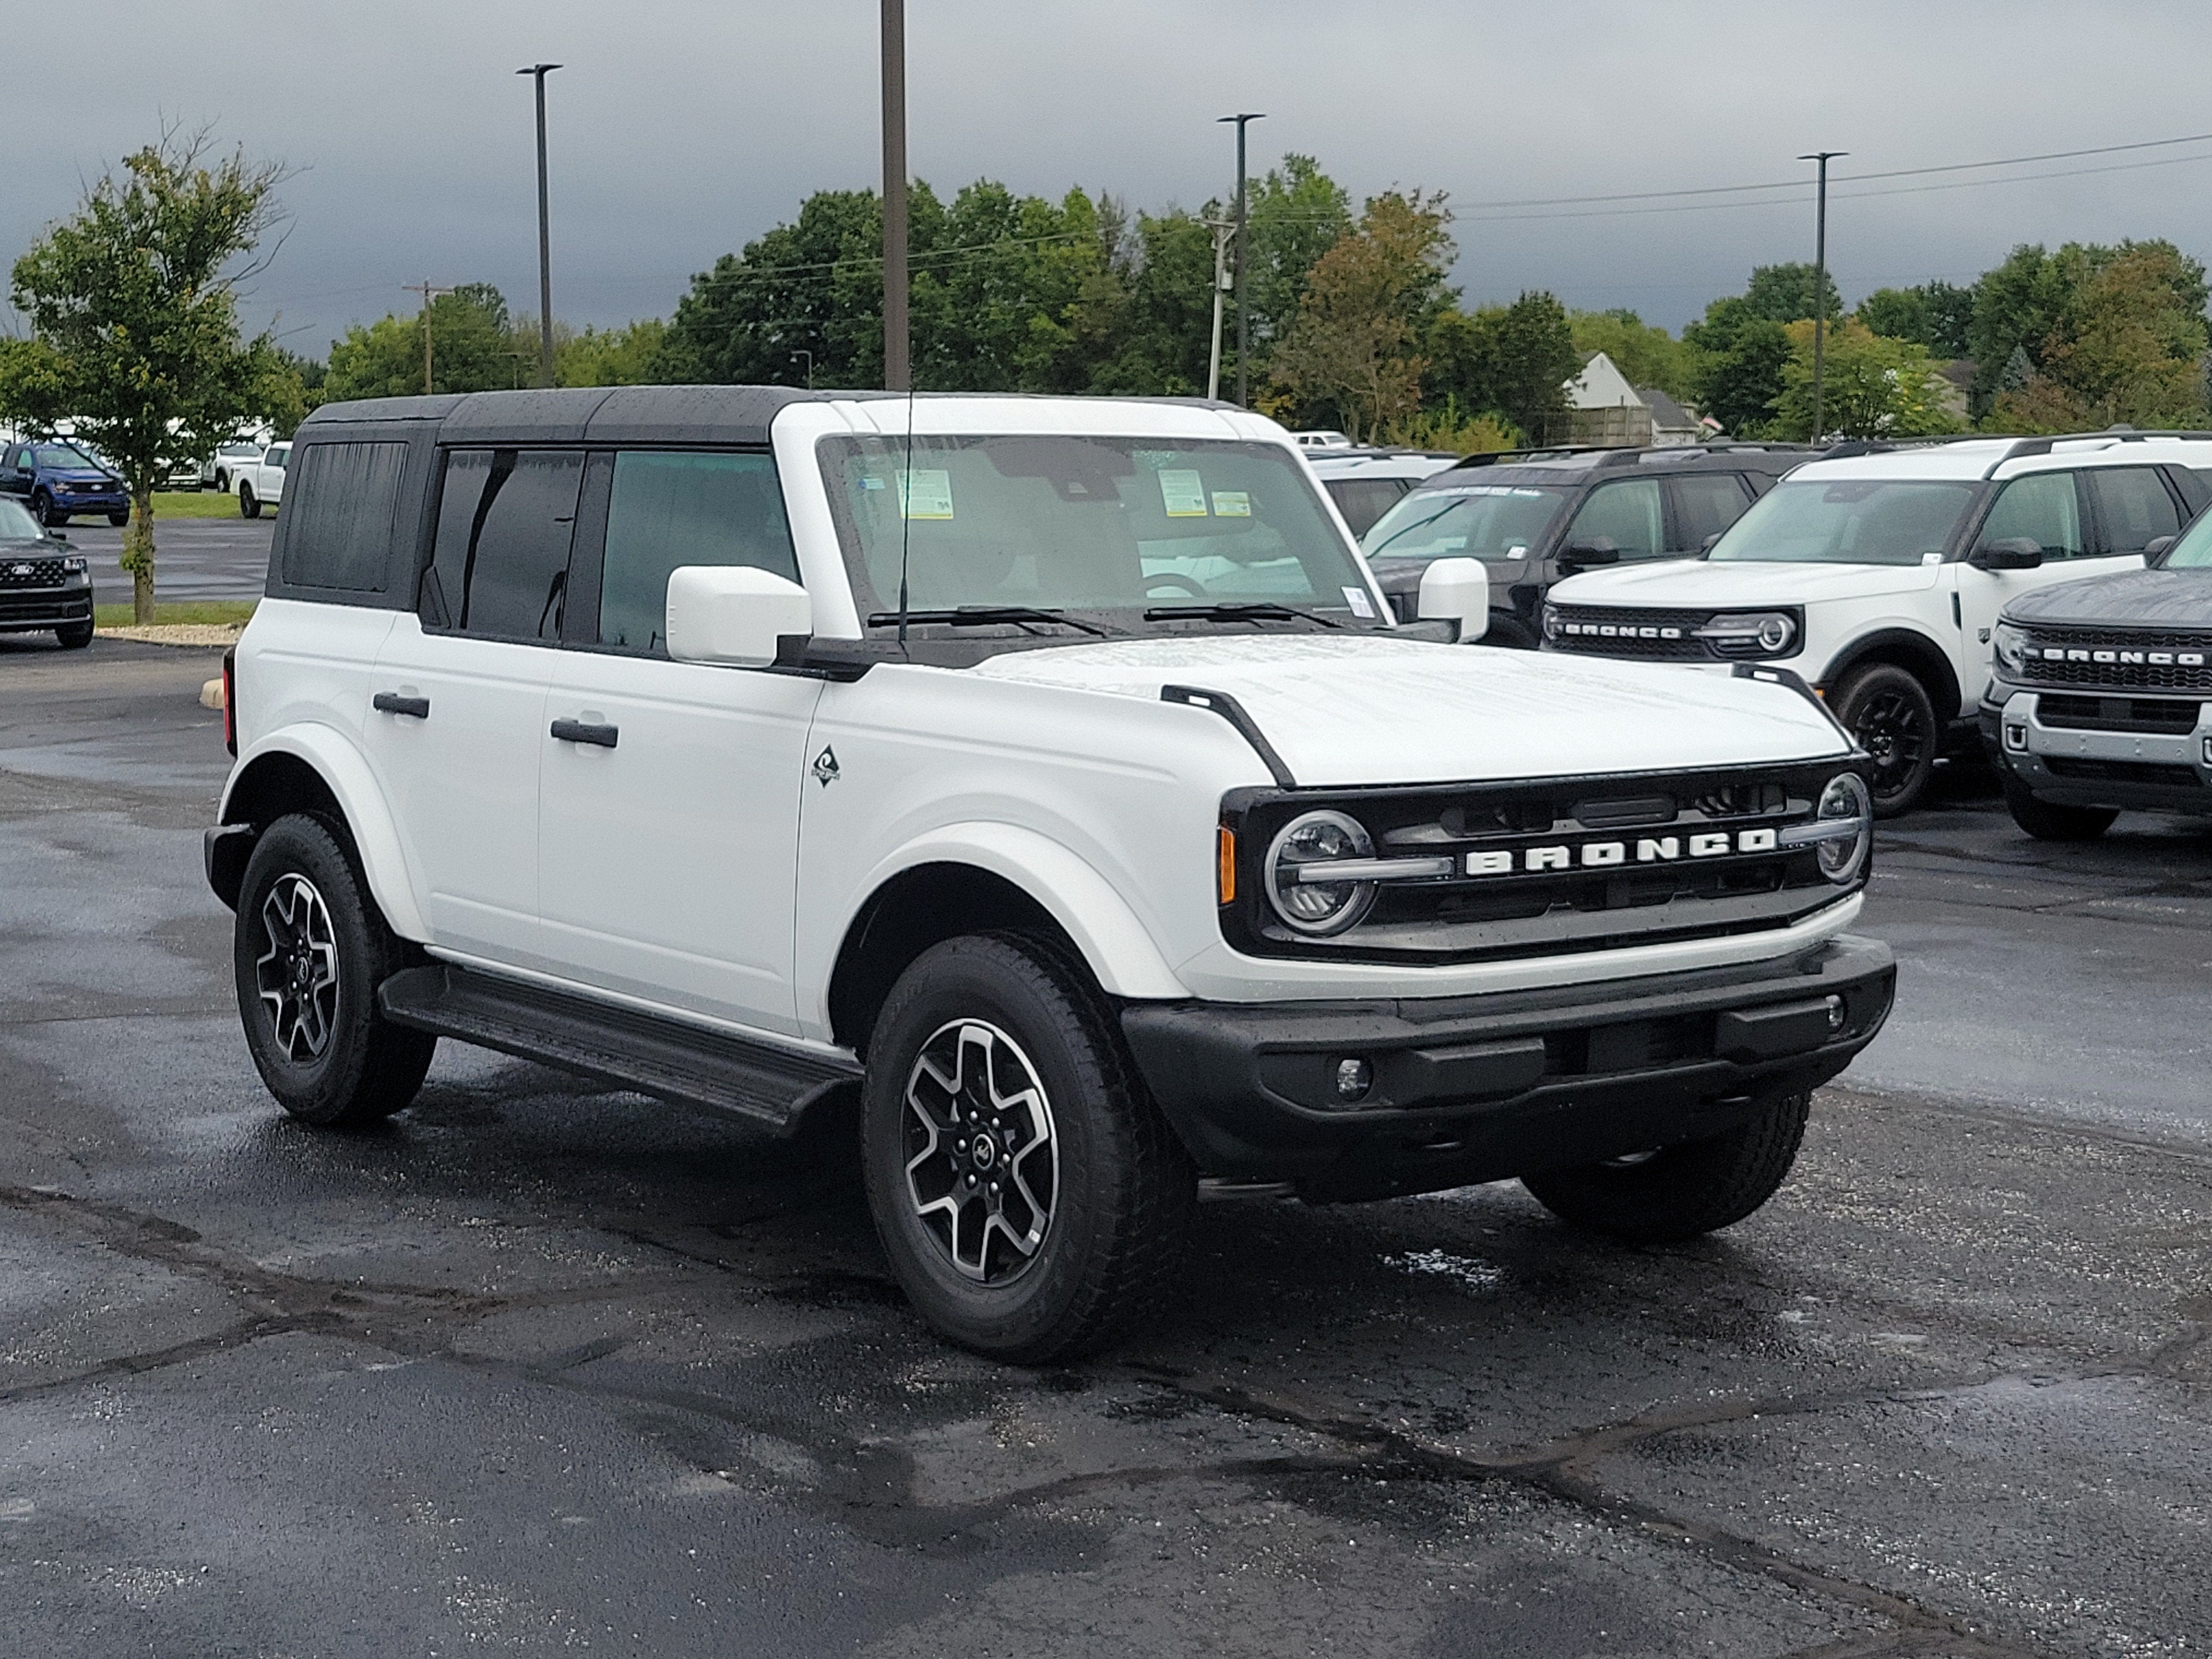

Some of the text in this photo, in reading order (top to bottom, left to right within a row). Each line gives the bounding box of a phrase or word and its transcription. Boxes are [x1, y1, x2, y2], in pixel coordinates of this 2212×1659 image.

[1565, 624, 1681, 639] BRONCO
[2043, 648, 2203, 665] BRONCO
[1466, 828, 1777, 876] BRONCO
